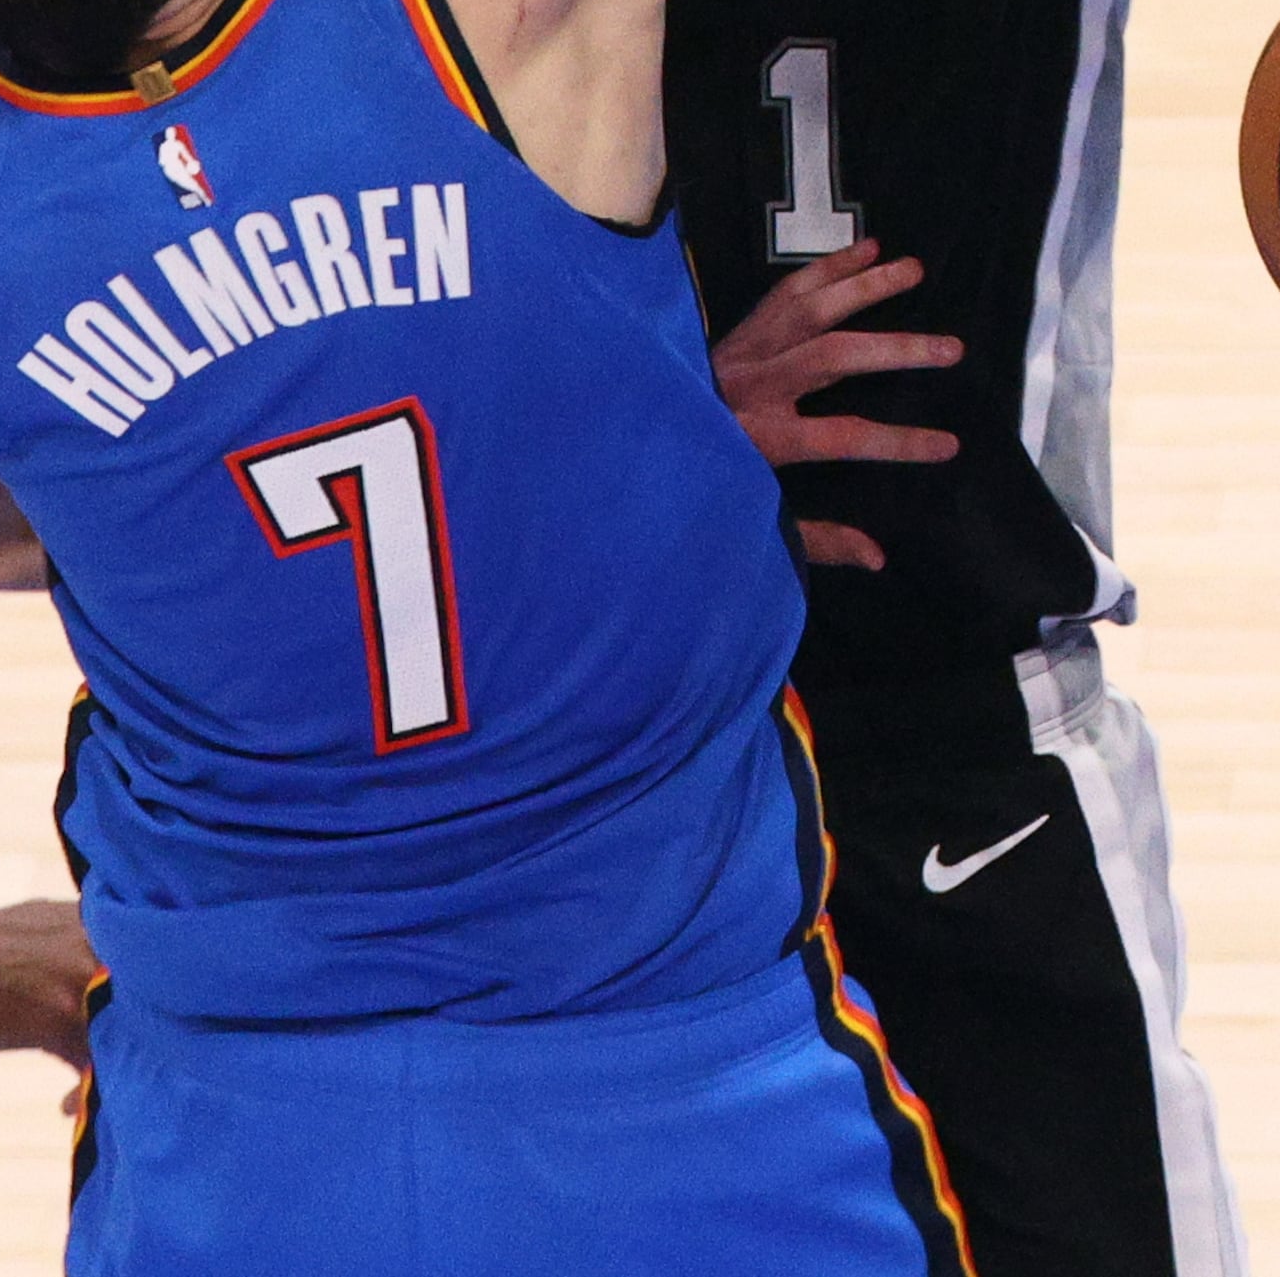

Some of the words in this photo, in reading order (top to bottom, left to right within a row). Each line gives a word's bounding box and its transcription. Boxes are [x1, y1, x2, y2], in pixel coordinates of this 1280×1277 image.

[761, 37, 863, 264] 1
[17, 182, 472, 438] HOLMGREN
[224, 395, 471, 756] 7
